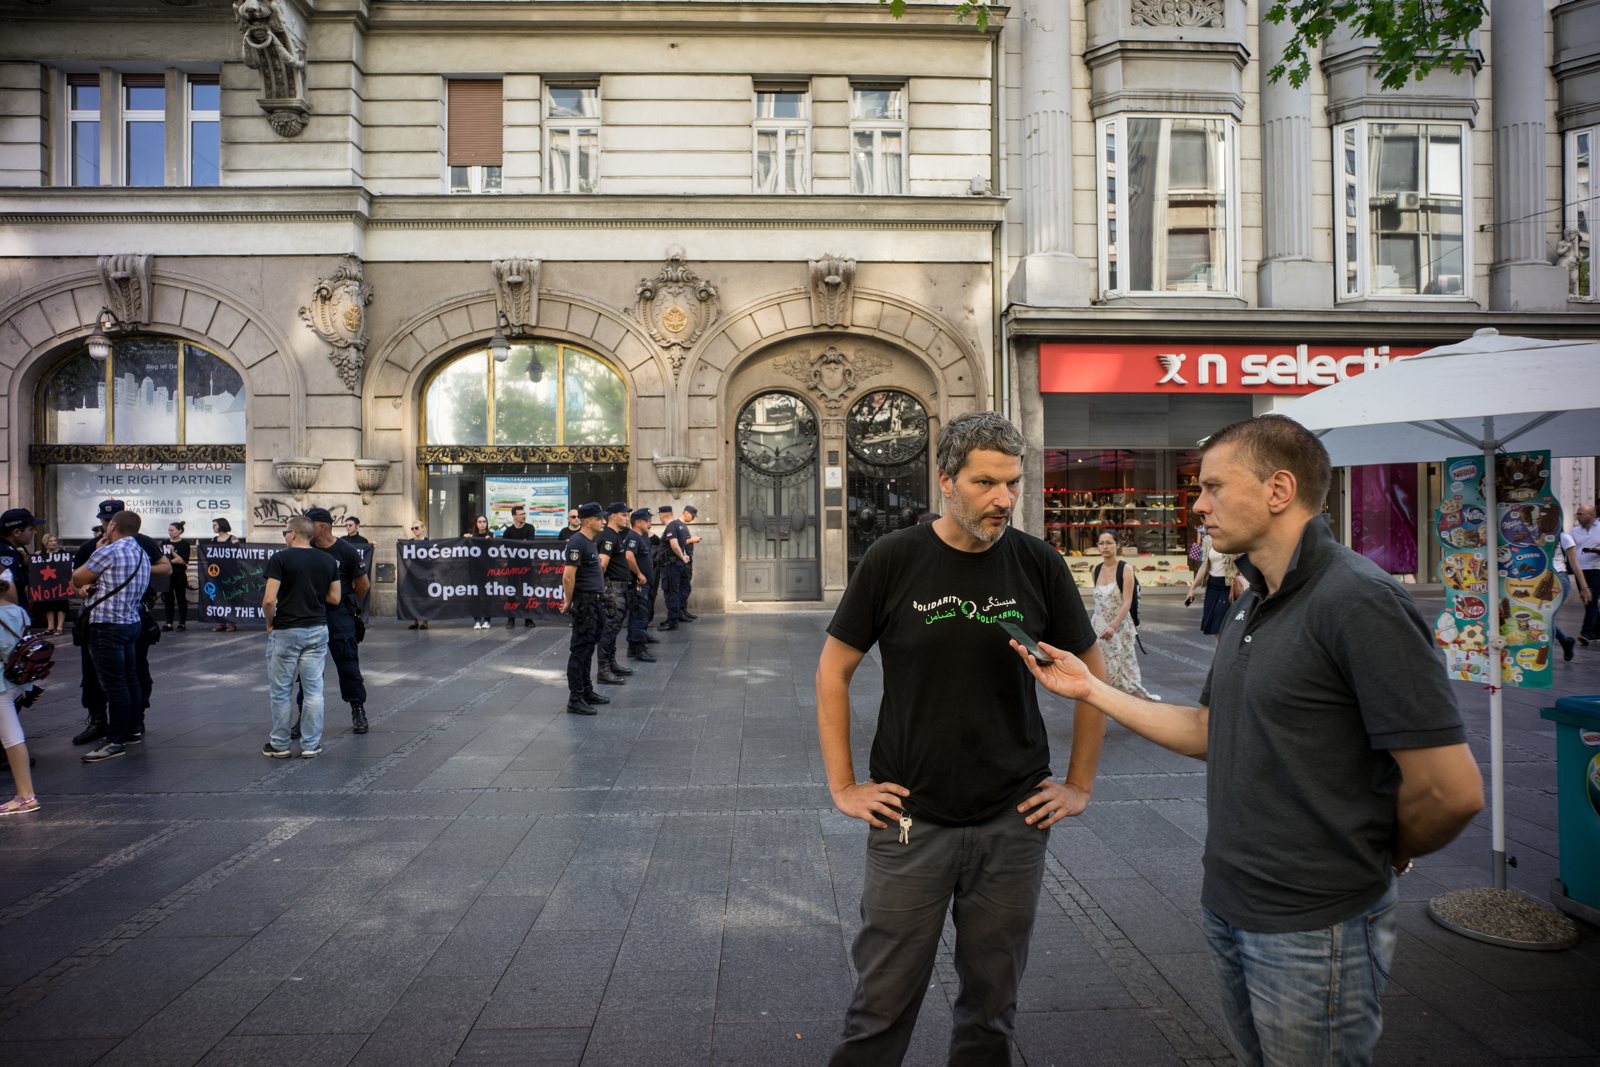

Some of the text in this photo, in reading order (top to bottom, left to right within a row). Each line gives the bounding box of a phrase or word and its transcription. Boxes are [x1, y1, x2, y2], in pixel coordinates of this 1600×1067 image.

[1241, 344, 1418, 385] select
[98, 475, 232, 484] THE RIGHT PARTNER
[196, 500, 231, 510] CBS
[206, 547, 264, 560] ZAUSTAVITE
[403, 544, 482, 560] Hoćemo
[428, 582, 567, 600] Open the bord
[912, 596, 963, 612] SOLIDARITY
[206, 606, 232, 616] STOP
[235, 607, 255, 618] THE
